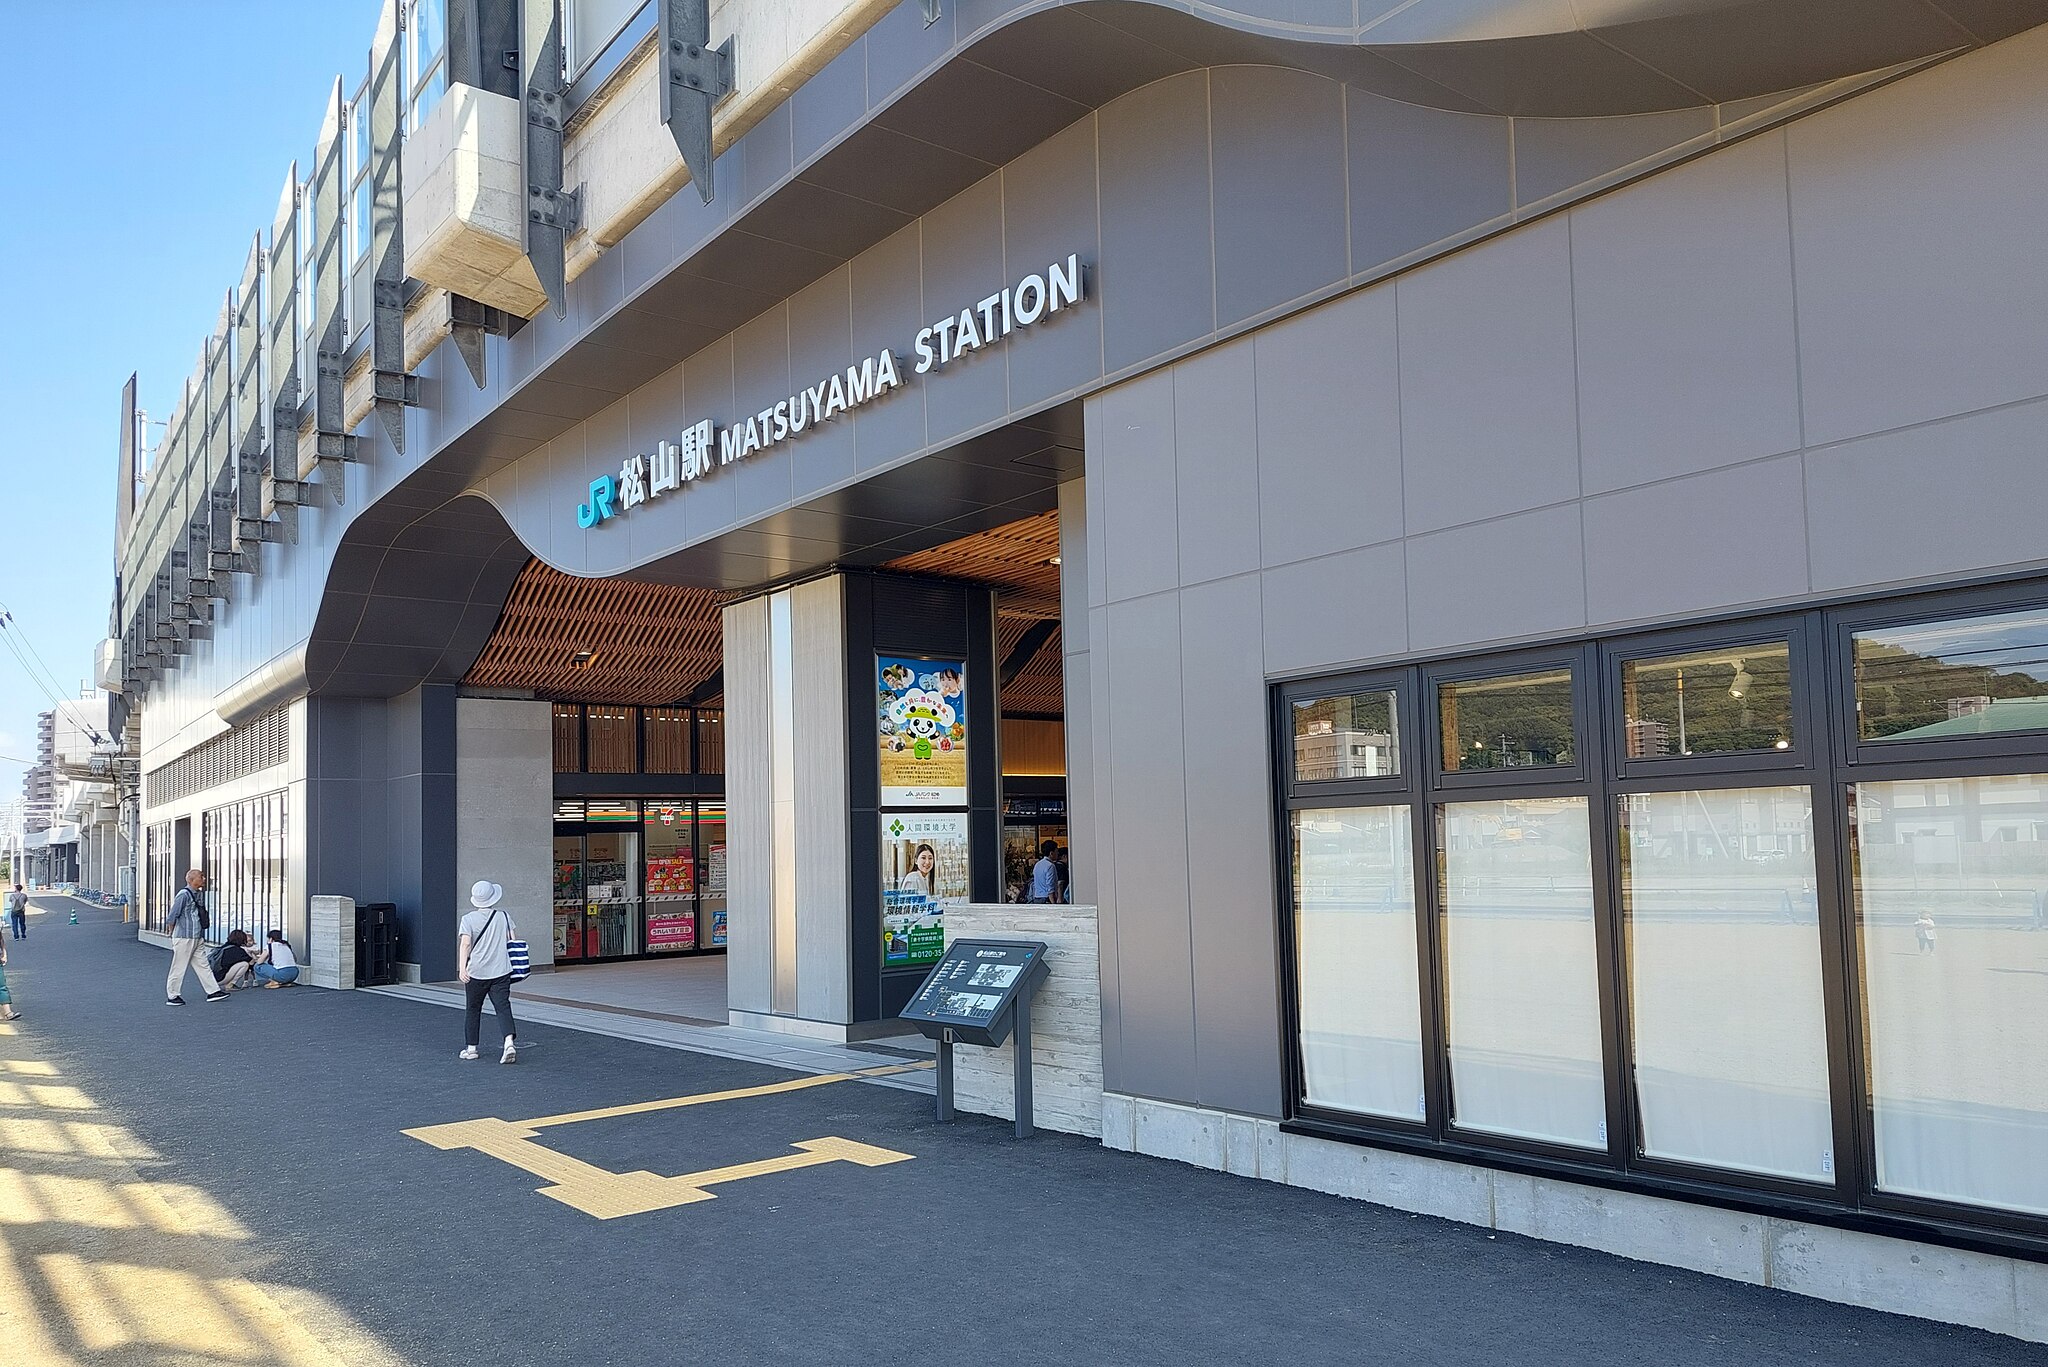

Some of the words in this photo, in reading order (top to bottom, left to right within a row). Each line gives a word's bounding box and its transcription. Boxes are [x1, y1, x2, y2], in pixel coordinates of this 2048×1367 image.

[577, 474, 614, 528] JR
[619, 419, 712, 511] 松山駅
[720, 348, 900, 466] MATSUYAMA
[914, 253, 1082, 374] STATION
[906, 823, 957, 832] 人間環境大学
[886, 896, 926, 905] 総合環境学部
[886, 903, 937, 915] 環境情報学科
[917, 949, 944, 958] 0120-35-
